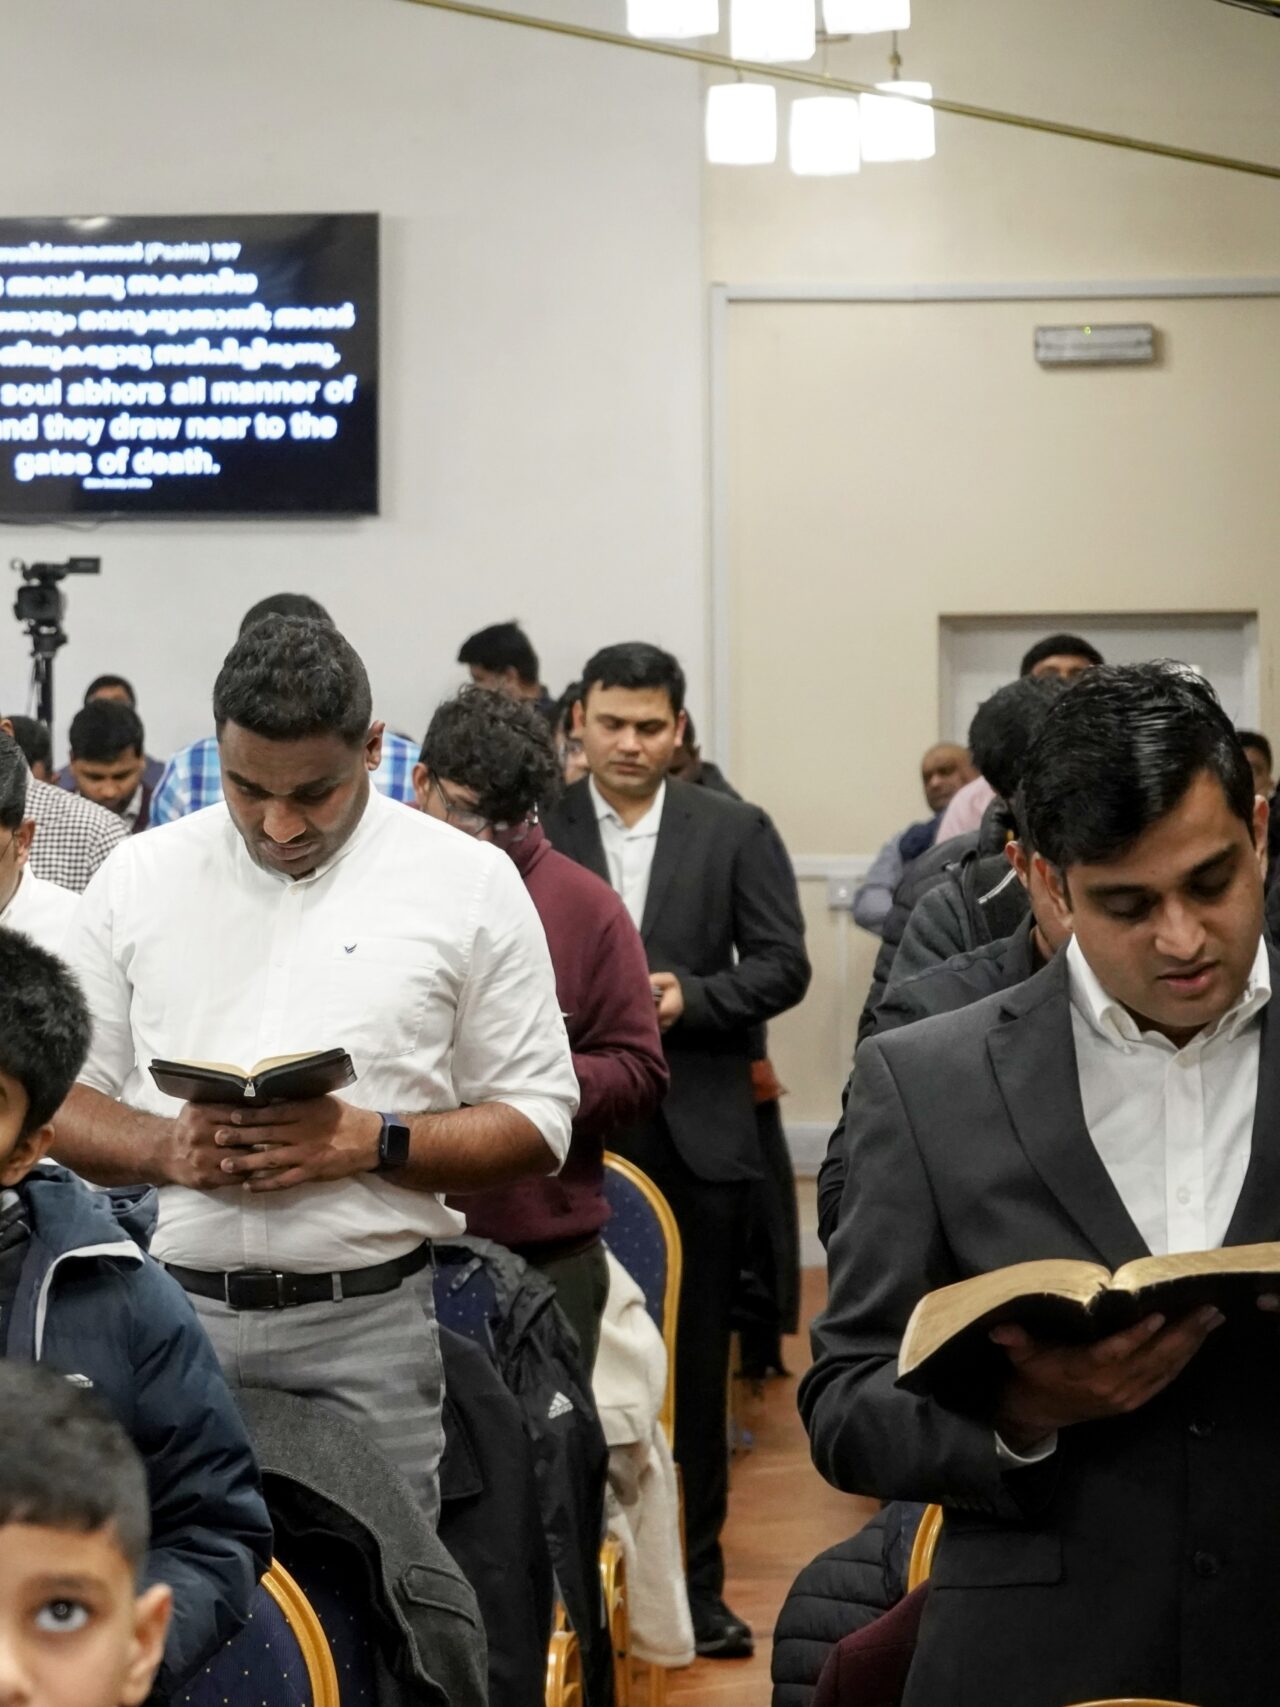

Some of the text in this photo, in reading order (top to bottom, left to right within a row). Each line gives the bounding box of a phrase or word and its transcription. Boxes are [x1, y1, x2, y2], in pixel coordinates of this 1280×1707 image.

[0, 378, 62, 406] soul
[67, 378, 166, 405] abhors
[171, 377, 206, 404] all
[211, 381, 321, 404] manner
[324, 375, 357, 403] of
[43, 413, 105, 446] they
[109, 412, 181, 440] draw
[186, 417, 251, 439] near
[254, 413, 285, 439] to
[290, 411, 337, 439] the
[15, 446, 220, 481] gates of death.
